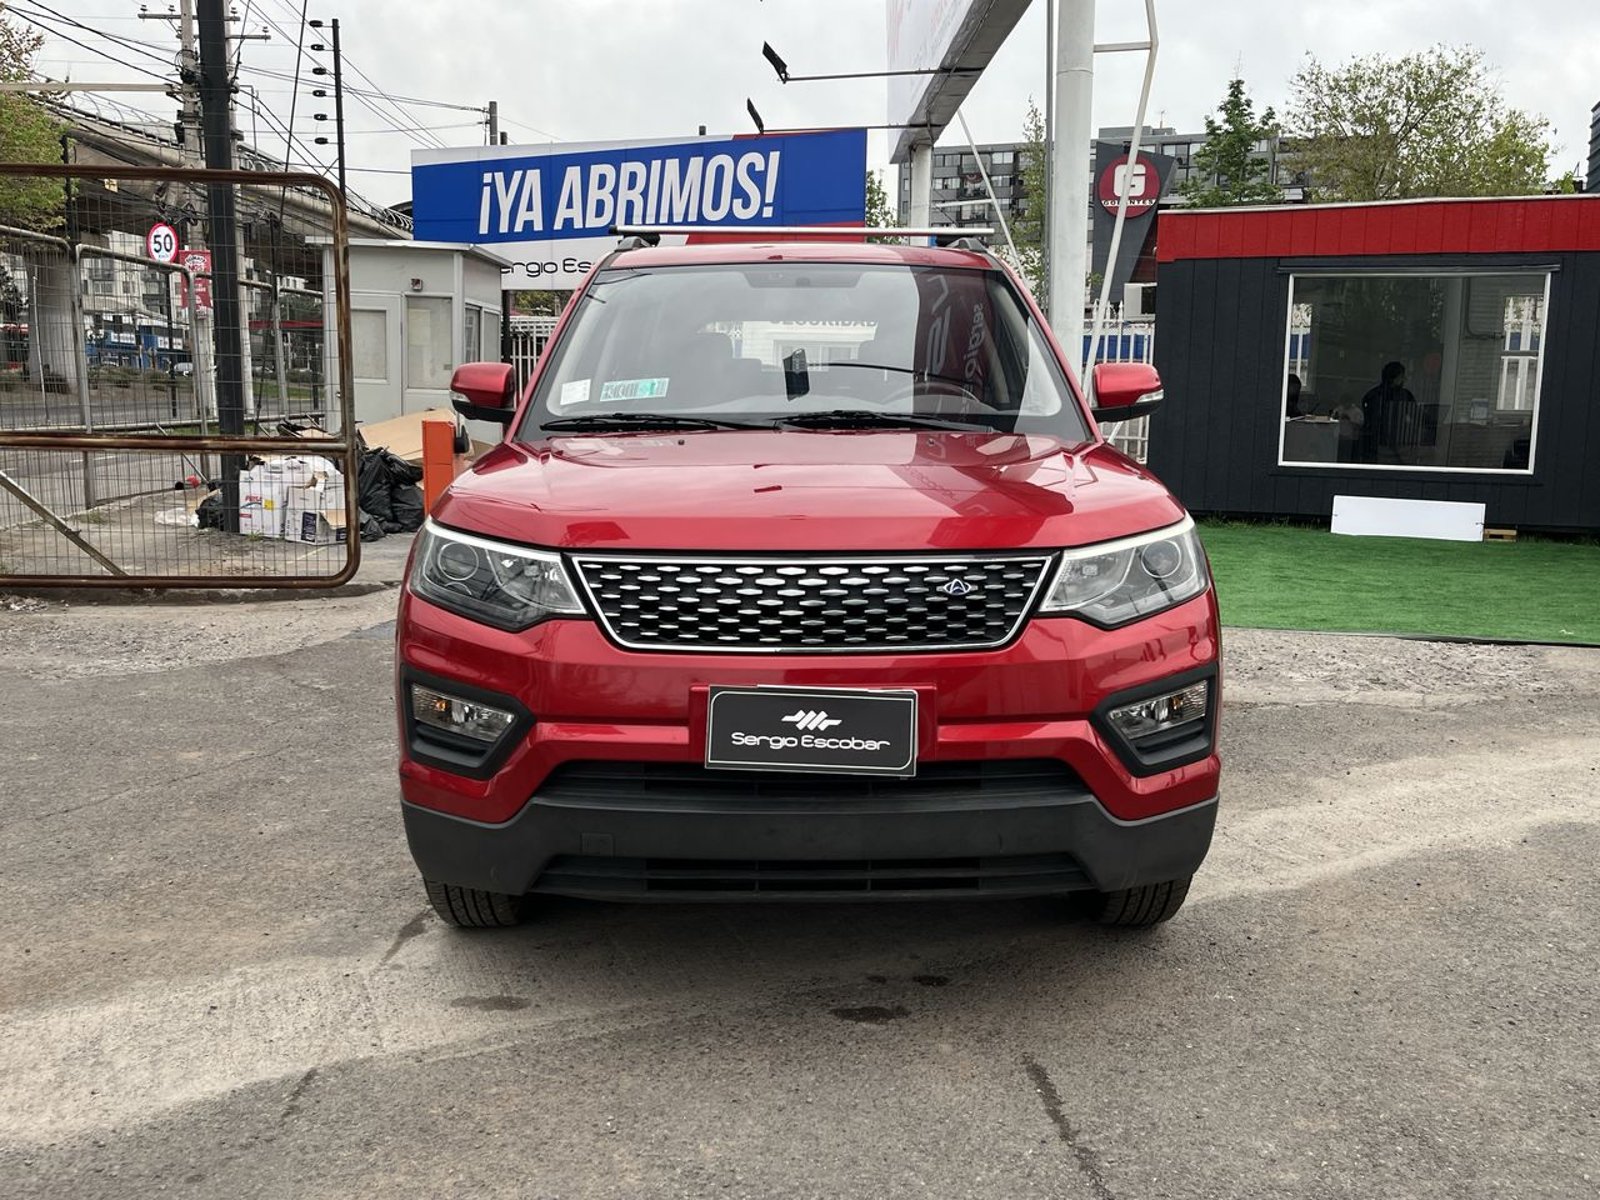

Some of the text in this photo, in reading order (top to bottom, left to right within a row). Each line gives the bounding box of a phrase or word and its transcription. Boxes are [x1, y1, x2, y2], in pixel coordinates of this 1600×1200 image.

[479, 150, 781, 235] ¡YA ABRIMOS!
[153, 233, 174, 254] 50
[731, 731, 891, 751] Sergio Escobar
